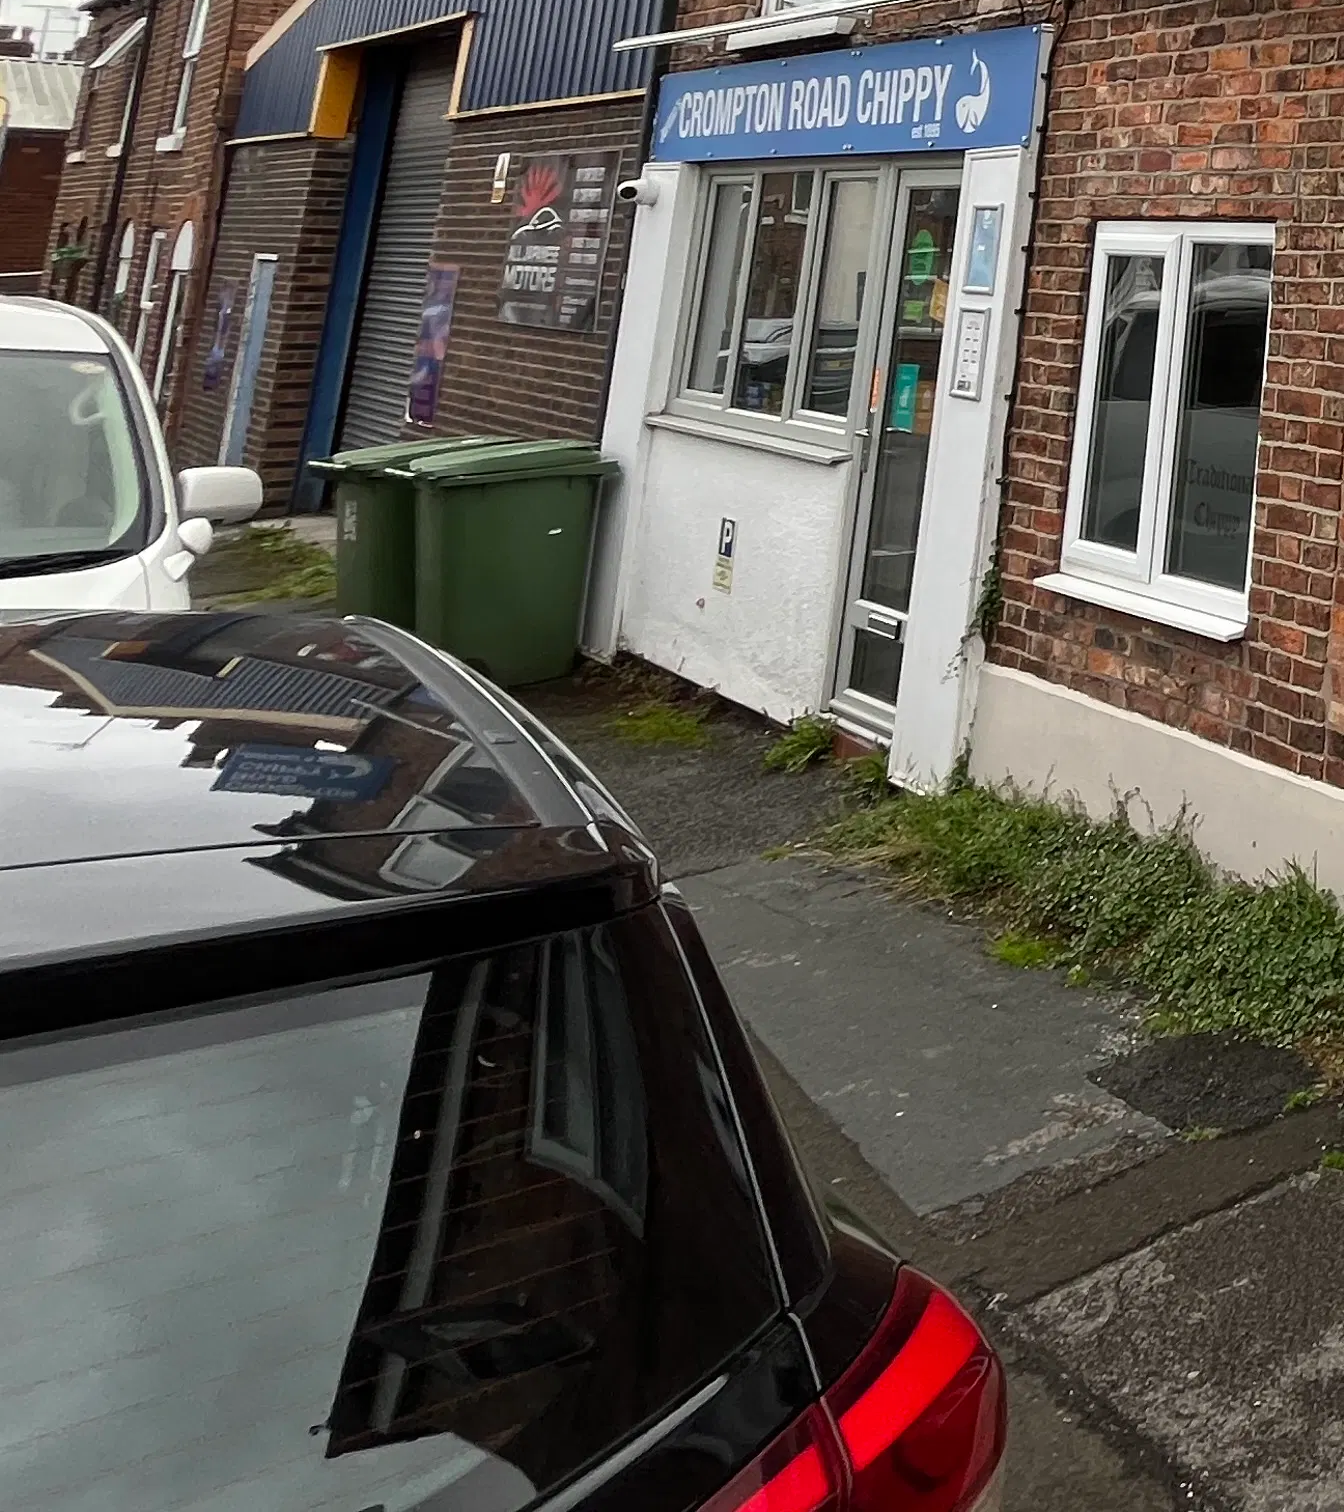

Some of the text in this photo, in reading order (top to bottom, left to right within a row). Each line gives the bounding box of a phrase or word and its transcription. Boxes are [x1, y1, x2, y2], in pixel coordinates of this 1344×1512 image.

[678, 64, 953, 139] CROMPTON ROAD CHIPPY
[720, 520, 734, 554] P
